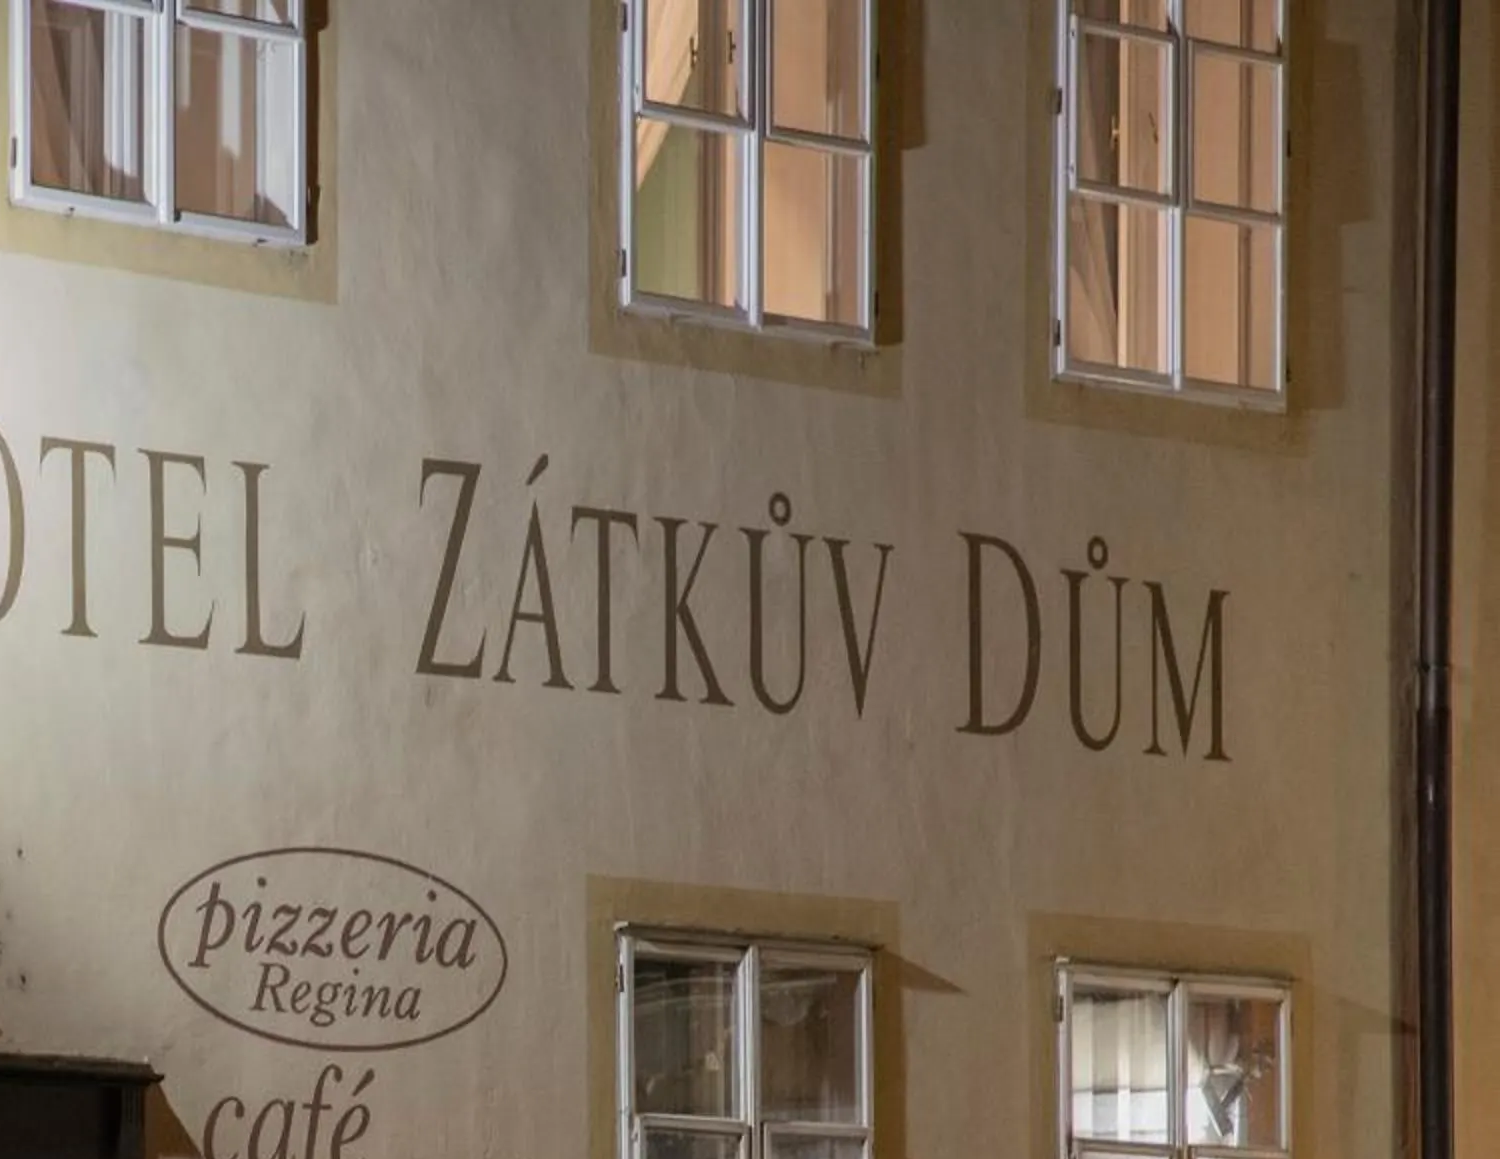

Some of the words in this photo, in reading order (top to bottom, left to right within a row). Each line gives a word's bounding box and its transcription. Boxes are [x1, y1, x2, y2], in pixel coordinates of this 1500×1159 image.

[415, 453, 895, 720] ZÁTKŮV
[956, 532, 1232, 762] DŮM
[187, 876, 478, 970] pizzeria
[249, 961, 423, 1028] Regina
